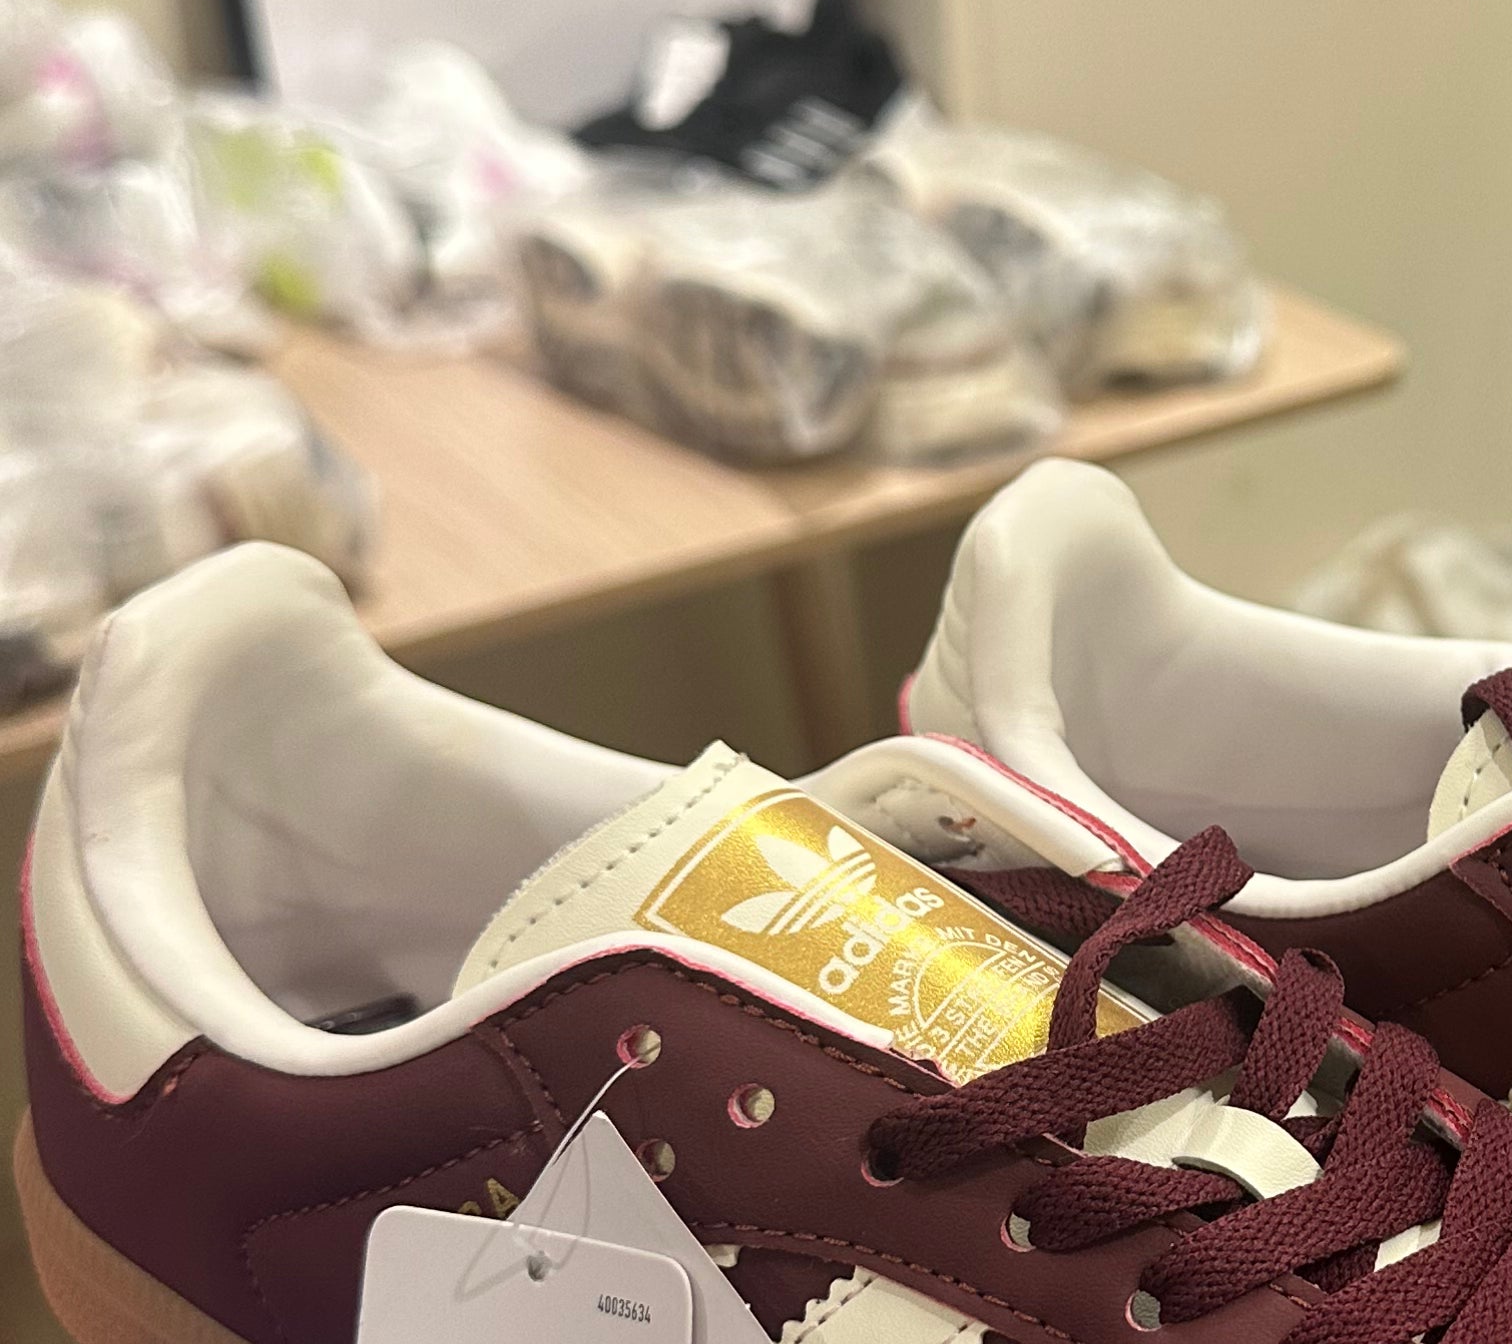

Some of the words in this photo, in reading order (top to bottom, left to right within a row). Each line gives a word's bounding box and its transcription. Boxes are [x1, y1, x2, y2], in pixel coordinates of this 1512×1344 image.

[818, 887, 944, 996] adidas
[935, 927, 975, 941] MIT
[597, 1294, 652, 1325] 40035634
